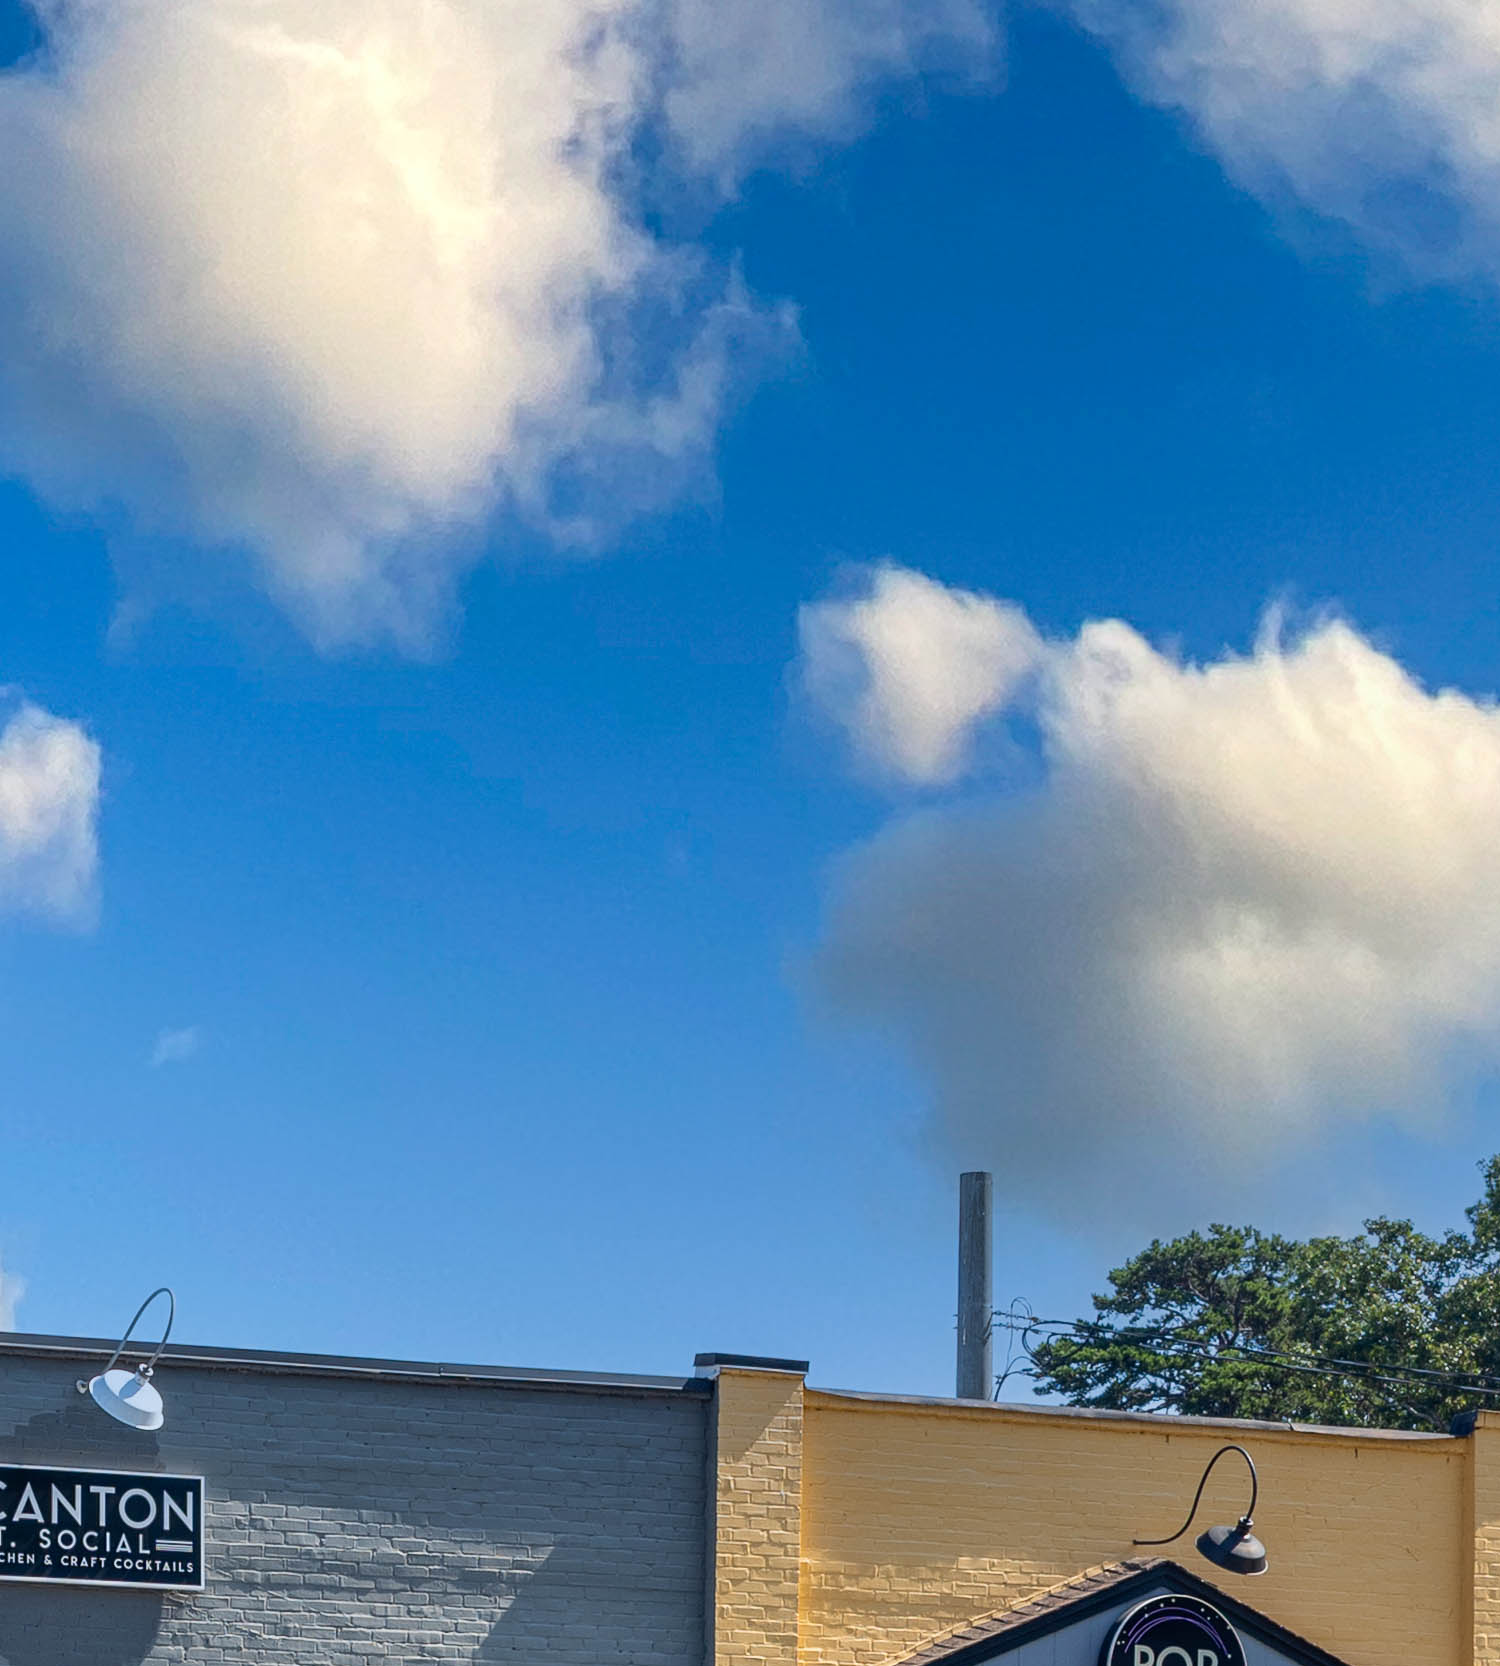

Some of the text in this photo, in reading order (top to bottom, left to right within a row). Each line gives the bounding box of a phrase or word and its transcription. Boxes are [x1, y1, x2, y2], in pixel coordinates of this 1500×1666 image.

[39, 1529, 150, 1555] SOCIAL
[44, 1555, 53, 1566] &
[60, 1555, 107, 1568] CRAFT
[114, 1559, 194, 1573] COCKTAILS
